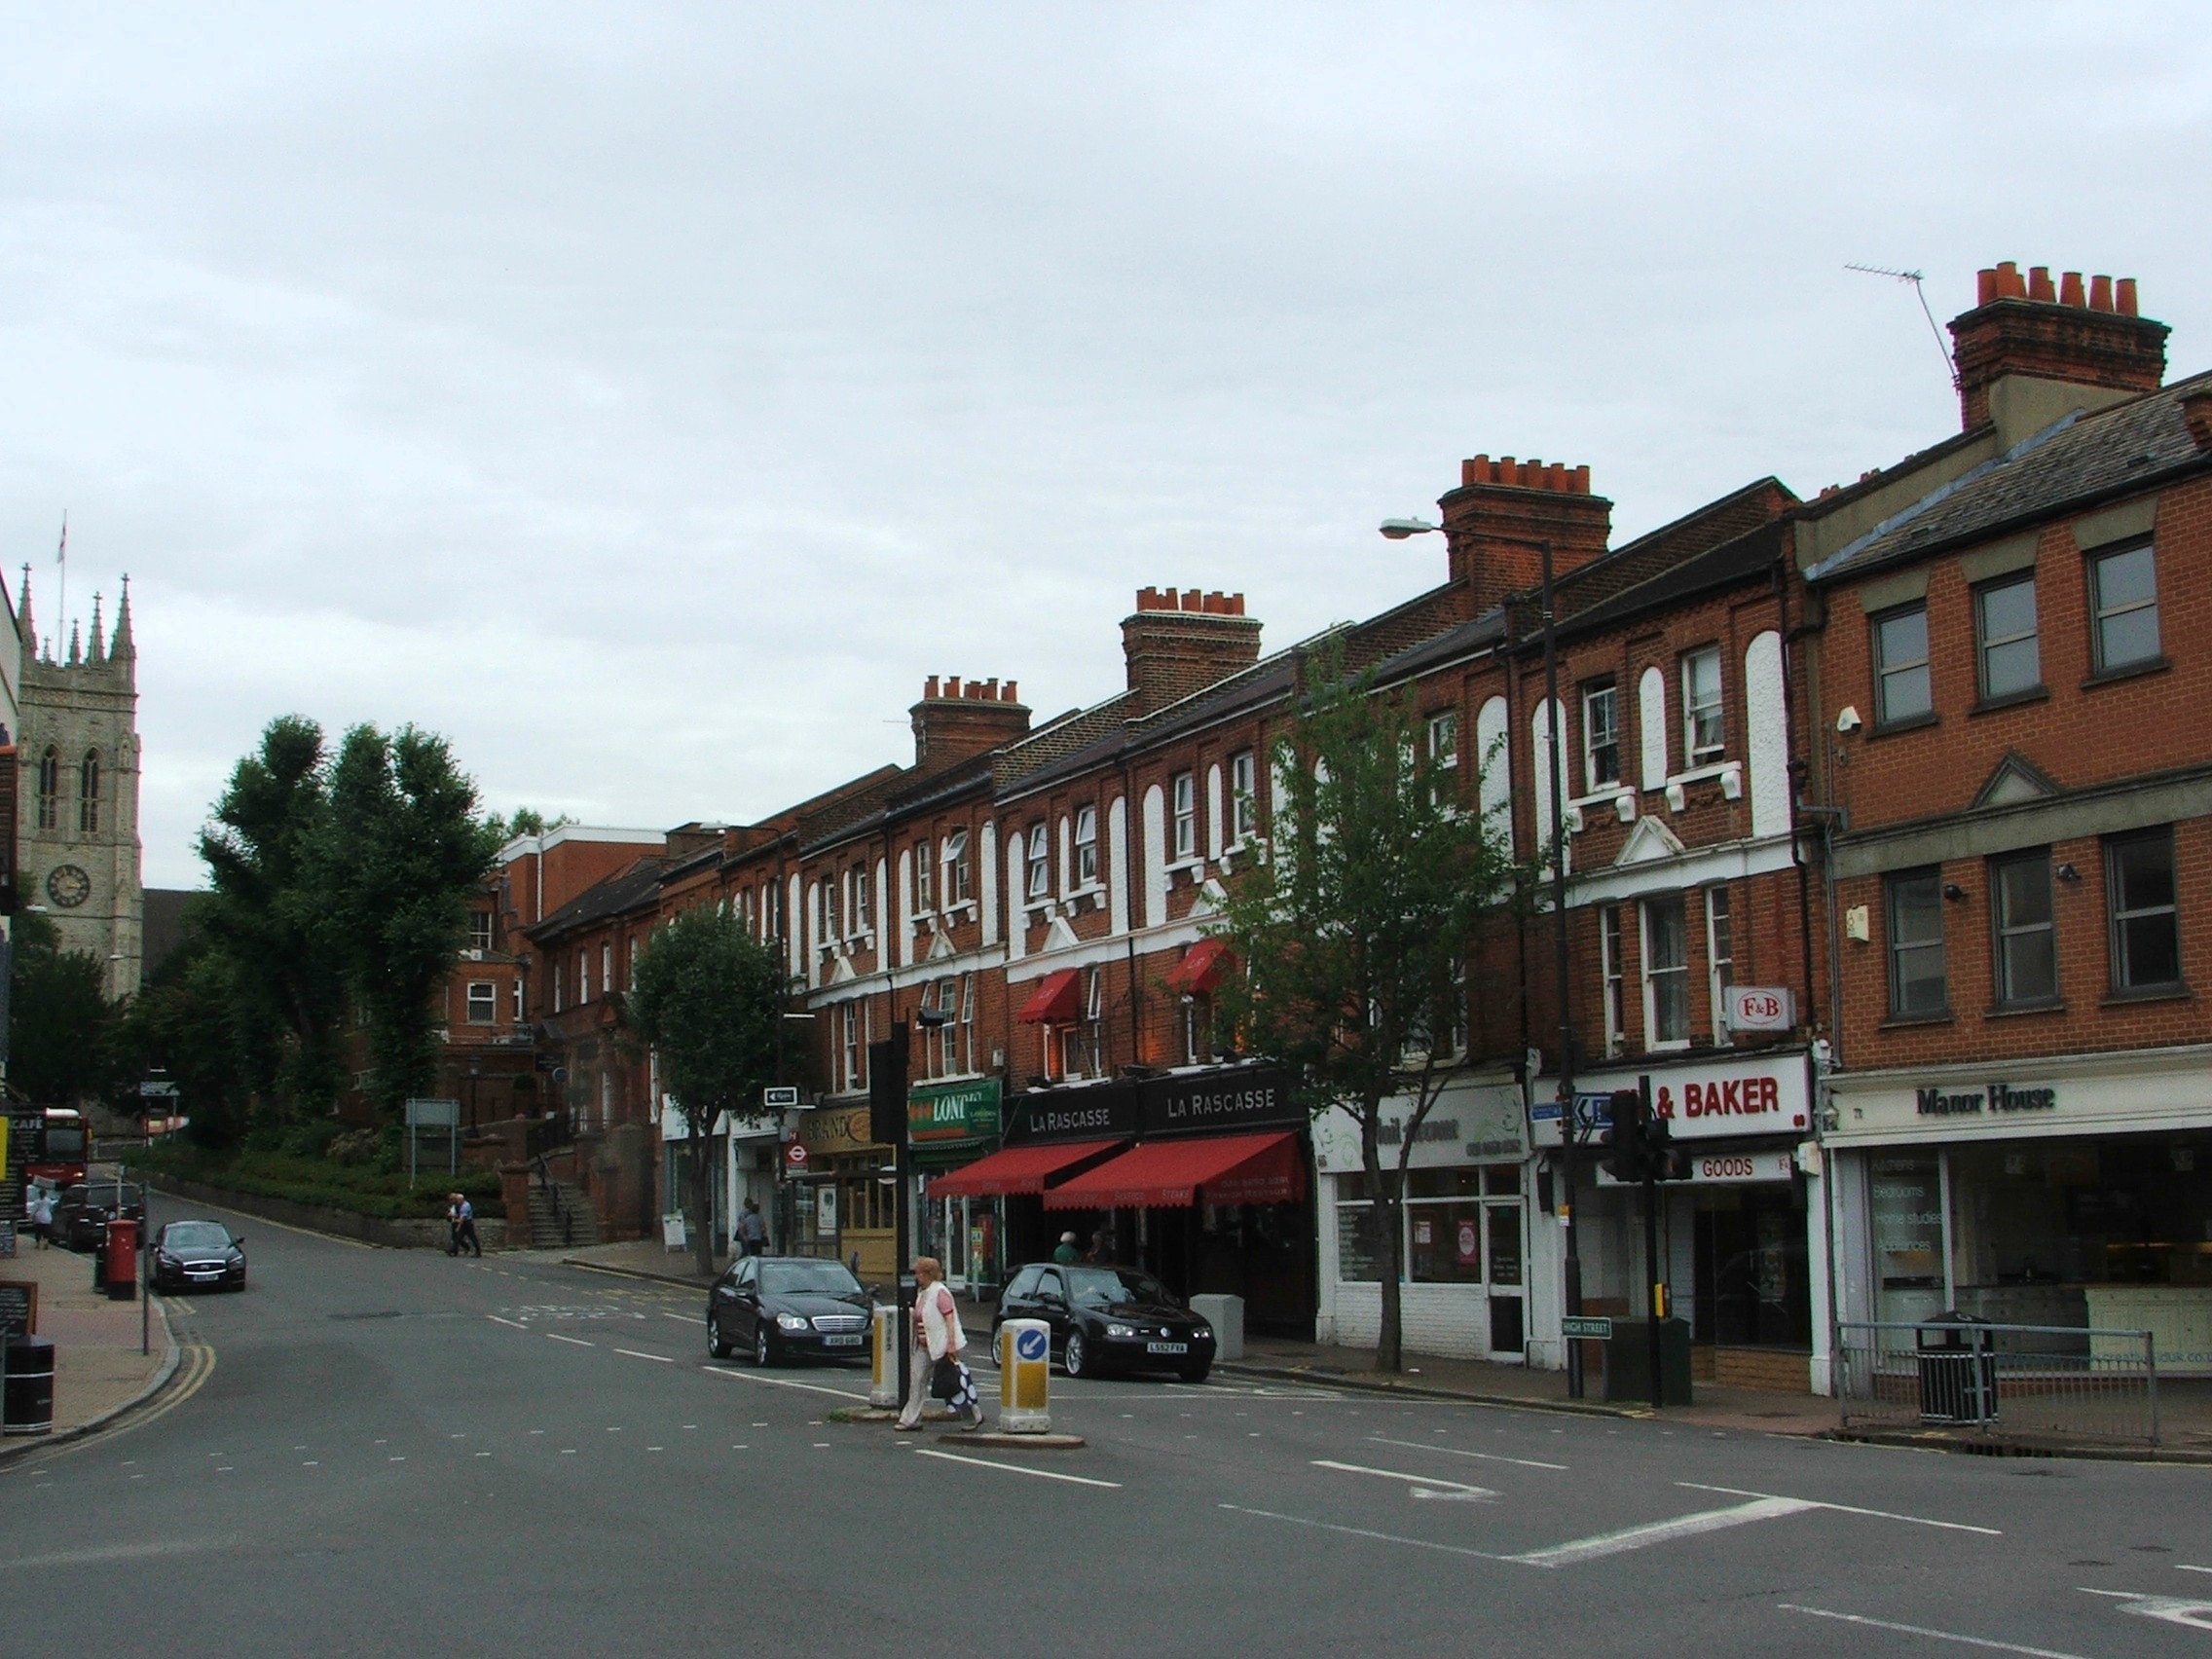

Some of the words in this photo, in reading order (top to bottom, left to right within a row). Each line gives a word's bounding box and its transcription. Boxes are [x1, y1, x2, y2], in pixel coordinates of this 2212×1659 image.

[1743, 997, 1779, 1016] F&B
[1167, 1097, 1188, 1119] LA
[1192, 1088, 1275, 1116] RASCASSE
[1685, 1077, 1780, 1118] BAKER
[1916, 1088, 1983, 1116] Manor
[1987, 1085, 2055, 1112] House
[1029, 1115, 1047, 1133] LA
[1048, 1108, 1111, 1131] RASCASSE
[1703, 1158, 1753, 1177] GOODS
[1582, 1322, 1608, 1334] STREET
